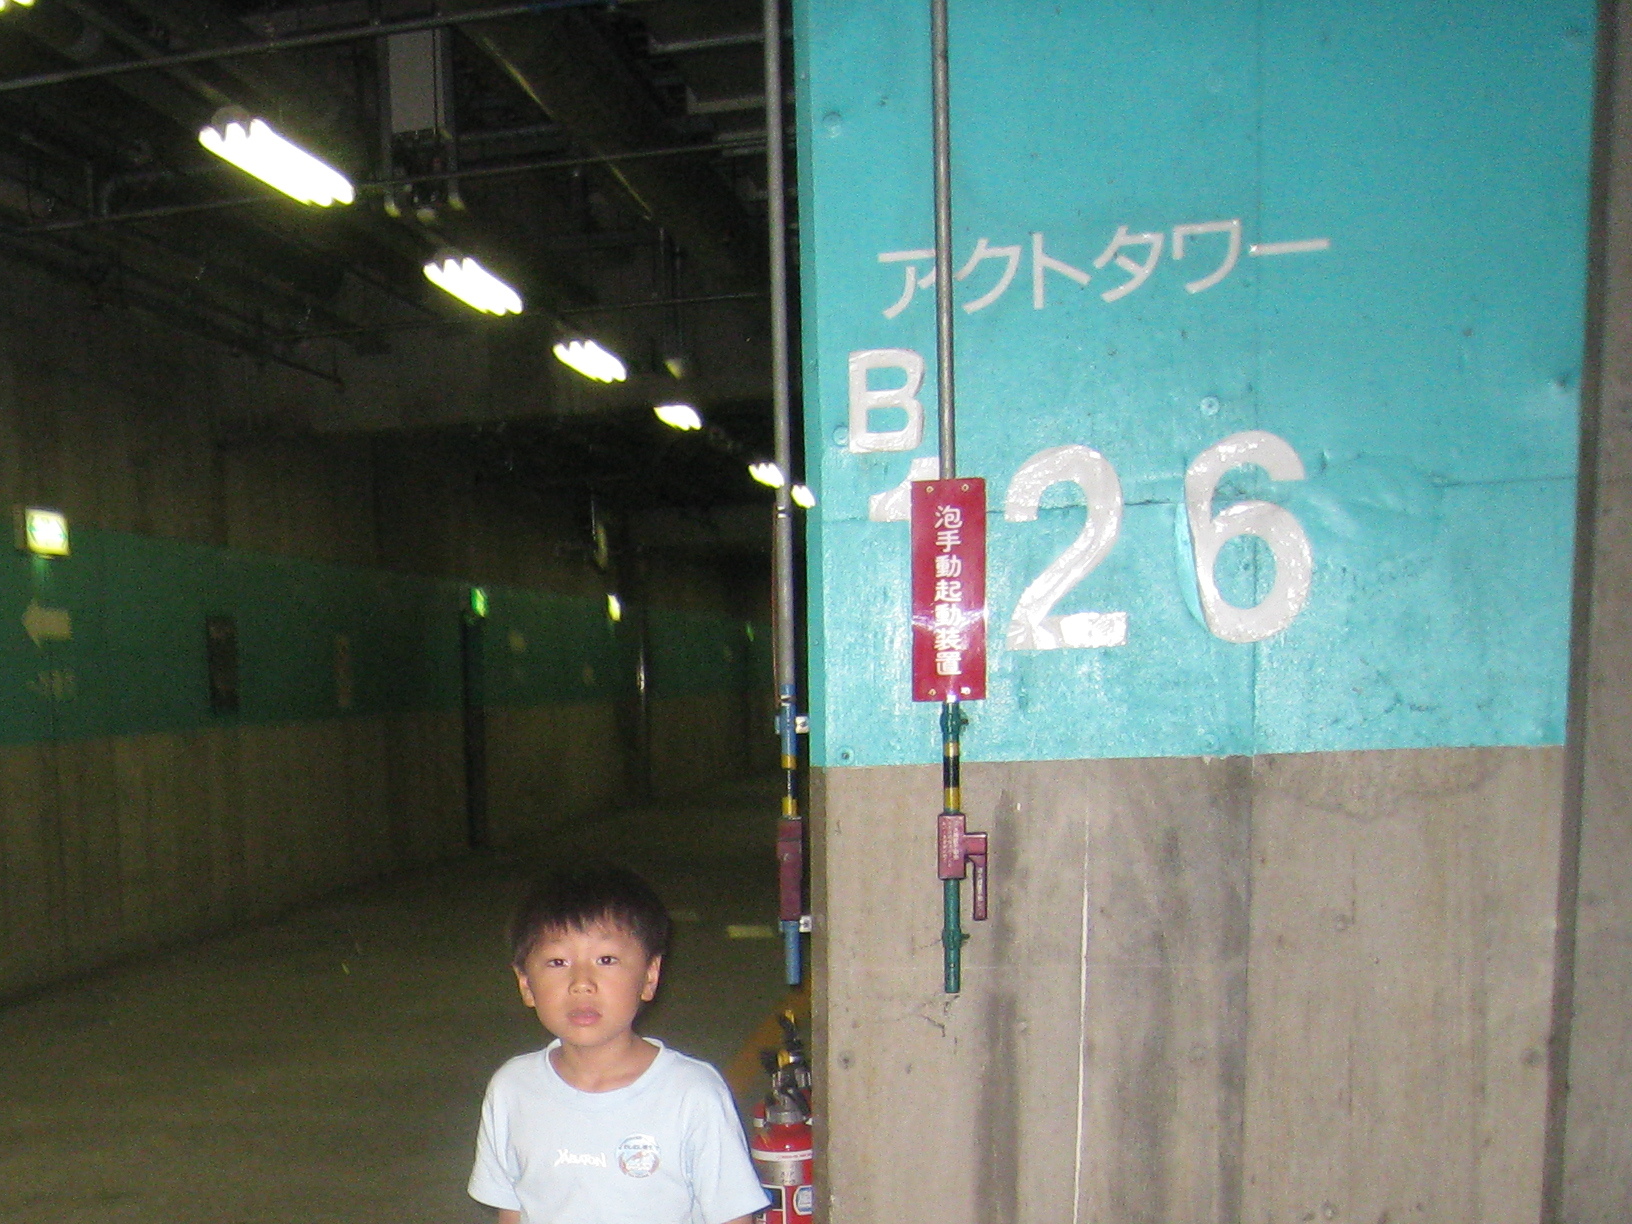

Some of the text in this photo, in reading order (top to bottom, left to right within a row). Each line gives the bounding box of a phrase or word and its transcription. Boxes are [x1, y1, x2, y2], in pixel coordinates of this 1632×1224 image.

[877, 218, 1331, 320] アクトタワー
[848, 348, 926, 454] B
[933, 504, 965, 677] 泡手動起動装置
